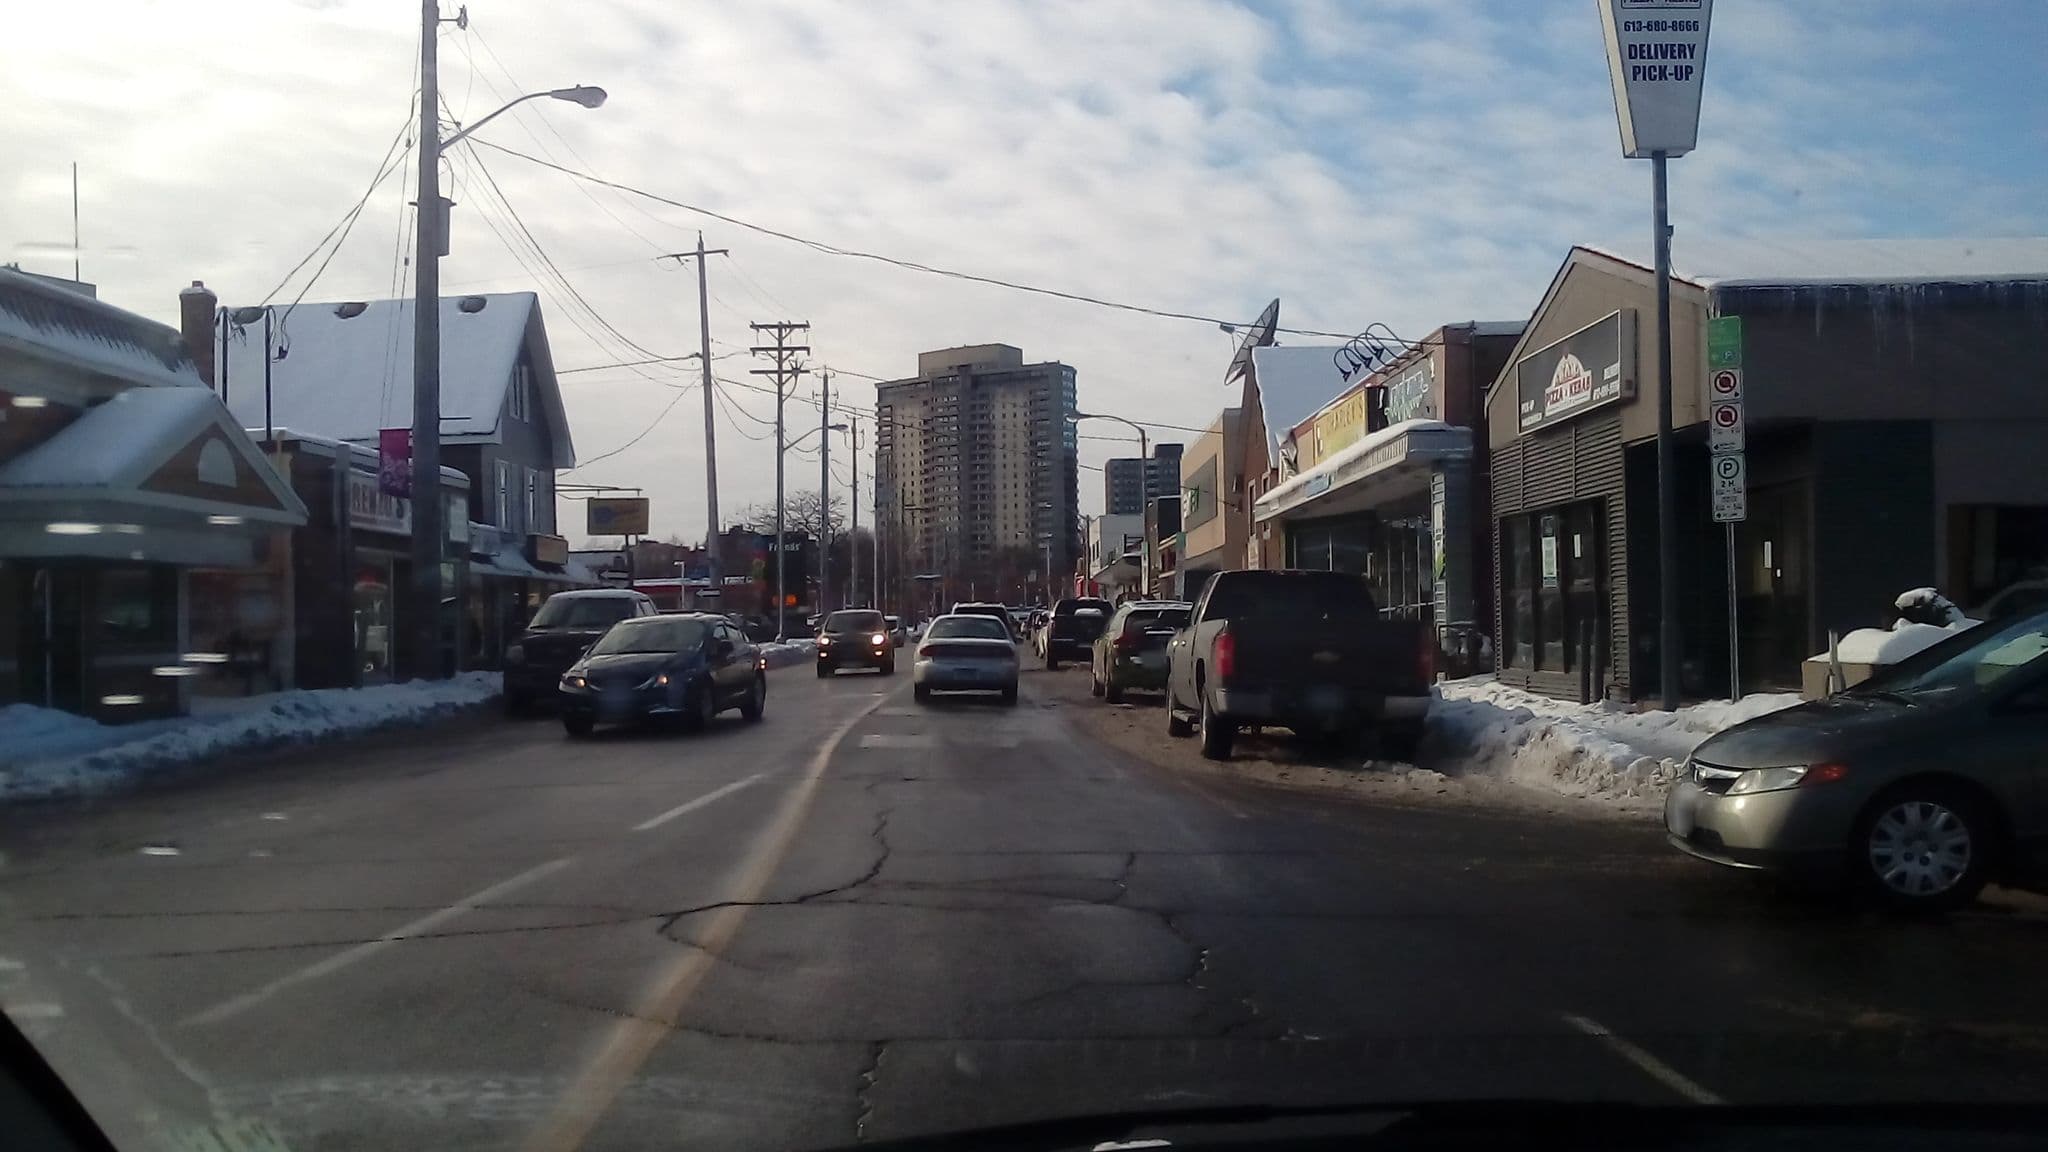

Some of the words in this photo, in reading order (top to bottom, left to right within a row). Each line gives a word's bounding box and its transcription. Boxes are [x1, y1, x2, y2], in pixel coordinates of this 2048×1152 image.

[1624, 20, 1699, 32] 613-680-8666
[1628, 43, 1696, 60] DELIVERY
[1632, 65, 1693, 82] PICK-UP
[1723, 462, 1733, 475] P
